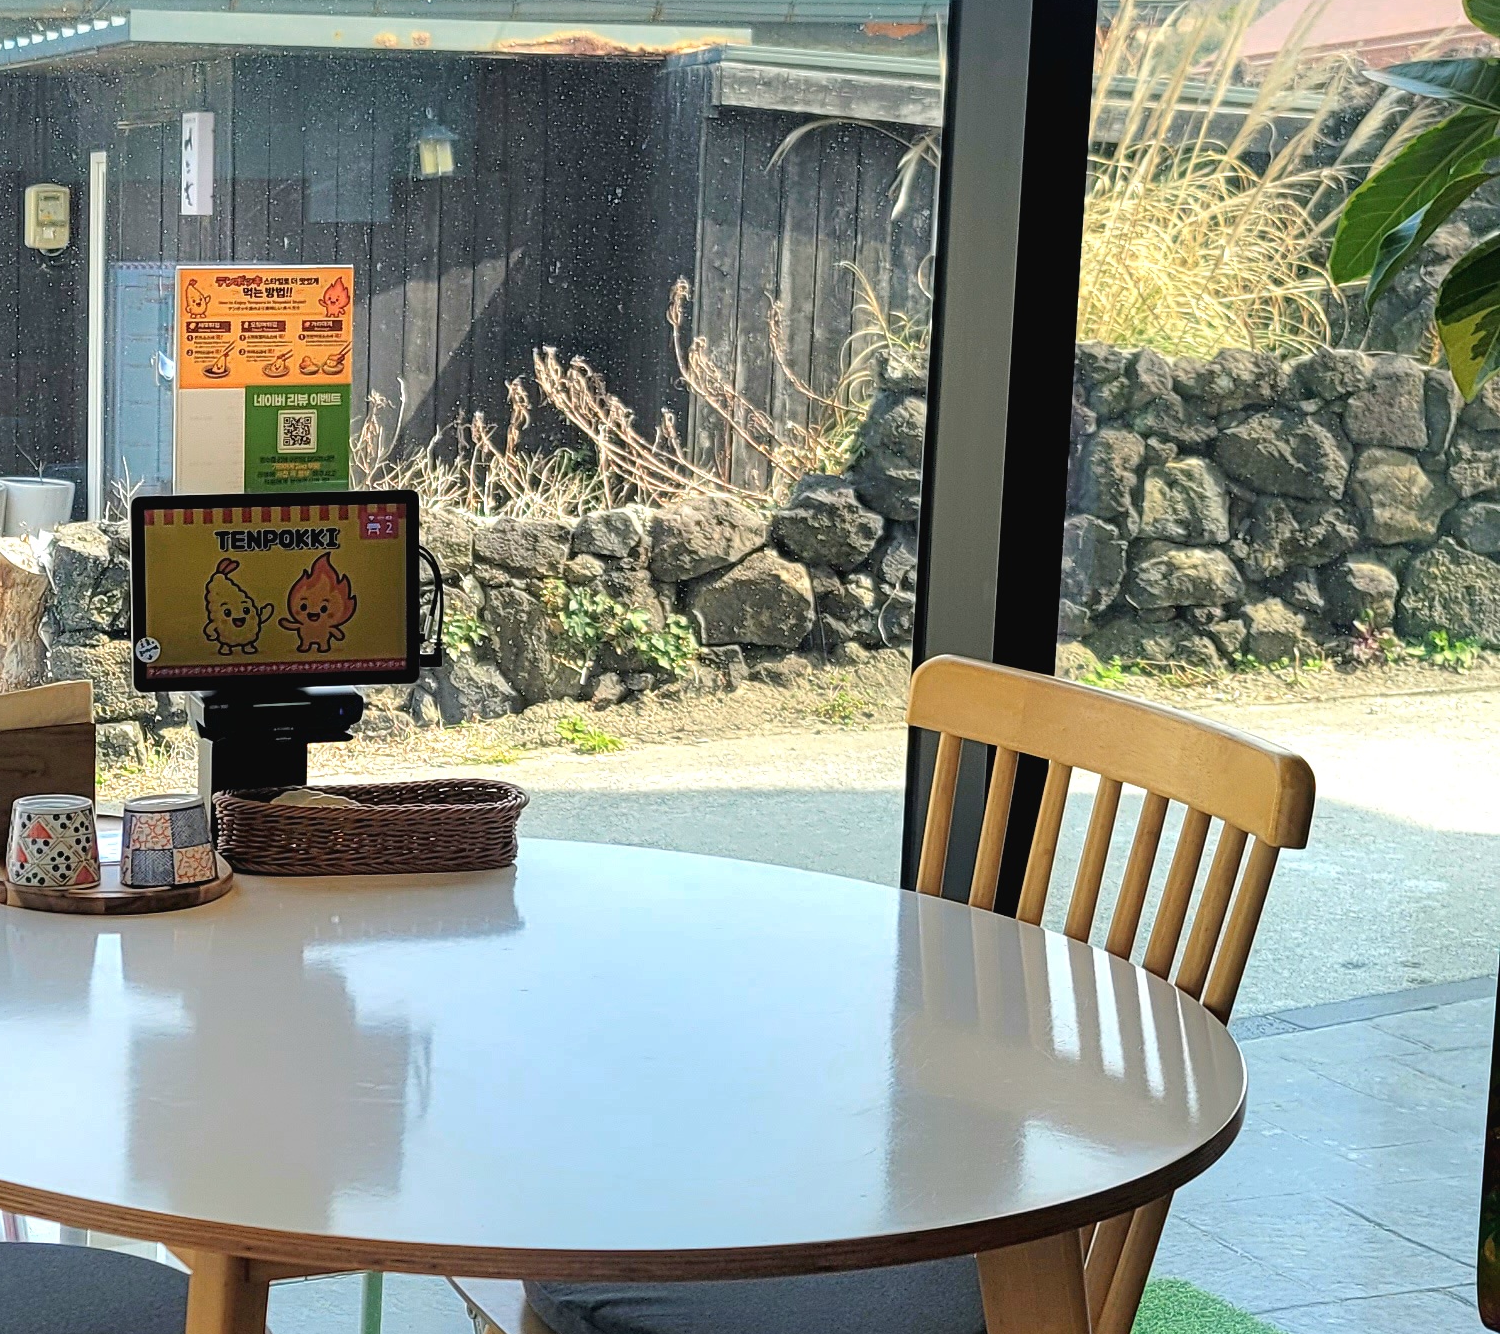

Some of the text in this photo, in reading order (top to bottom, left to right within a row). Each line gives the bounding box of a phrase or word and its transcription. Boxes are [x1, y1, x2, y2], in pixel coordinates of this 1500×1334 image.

[291, 277, 298, 285] 더
[242, 287, 293, 299] 먹는 방법!!
[253, 393, 342, 407] 네이버 리뷰 이벤트
[385, 522, 393, 534] 2
[214, 527, 341, 552] TENPOKKI
